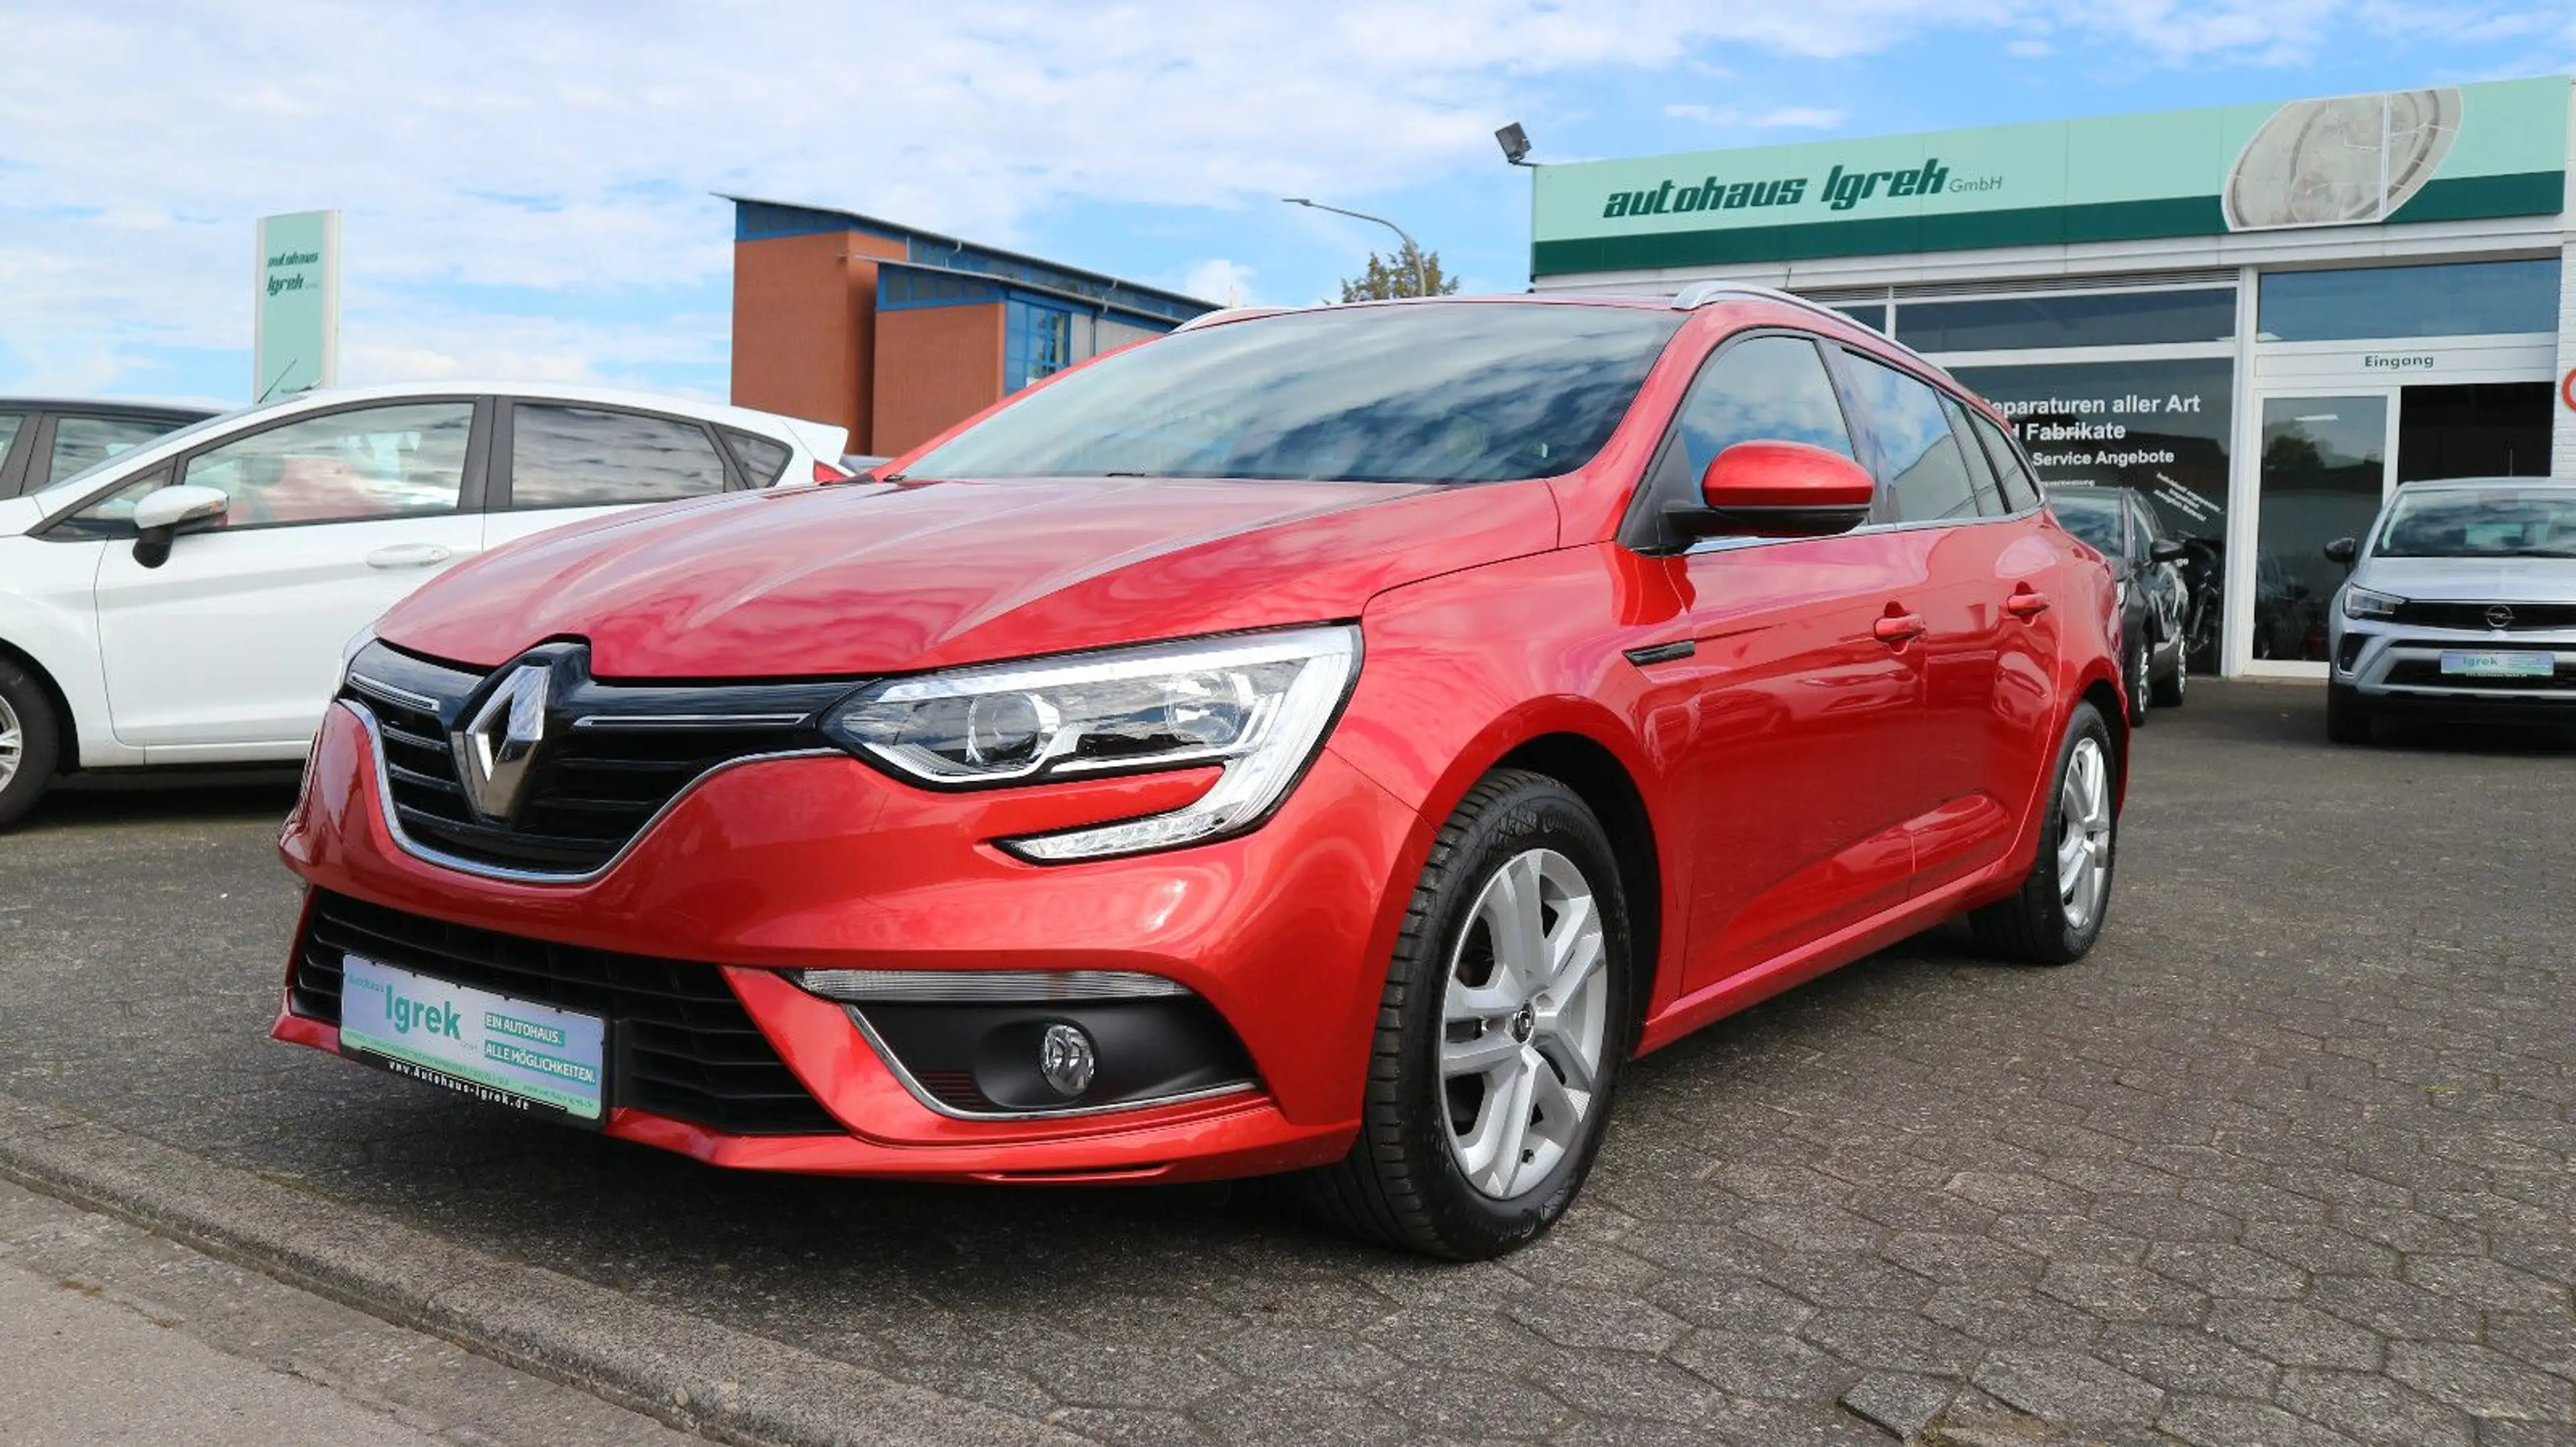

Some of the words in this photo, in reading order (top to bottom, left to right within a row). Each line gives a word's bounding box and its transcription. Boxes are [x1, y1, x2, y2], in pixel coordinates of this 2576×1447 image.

[1603, 175, 1807, 219] autohaus
[1820, 158, 1949, 211] Igrek
[1949, 174, 2002, 194] GmbH
[267, 251, 319, 268] autohaus
[2364, 355, 2434, 370] Eingang
[1984, 397, 2105, 418] eparaturen
[2112, 394, 2161, 413] aller
[2165, 394, 2201, 413] Art
[2026, 421, 2127, 441] Fabrikate
[2032, 451, 2092, 466] Service
[2096, 449, 2175, 468] Angebote
[385, 984, 462, 1040] Igrek
[485, 1014, 502, 1030] EIN
[503, 1020, 564, 1044] AUTOHAUS.
[486, 1044, 511, 1061] ALLE
